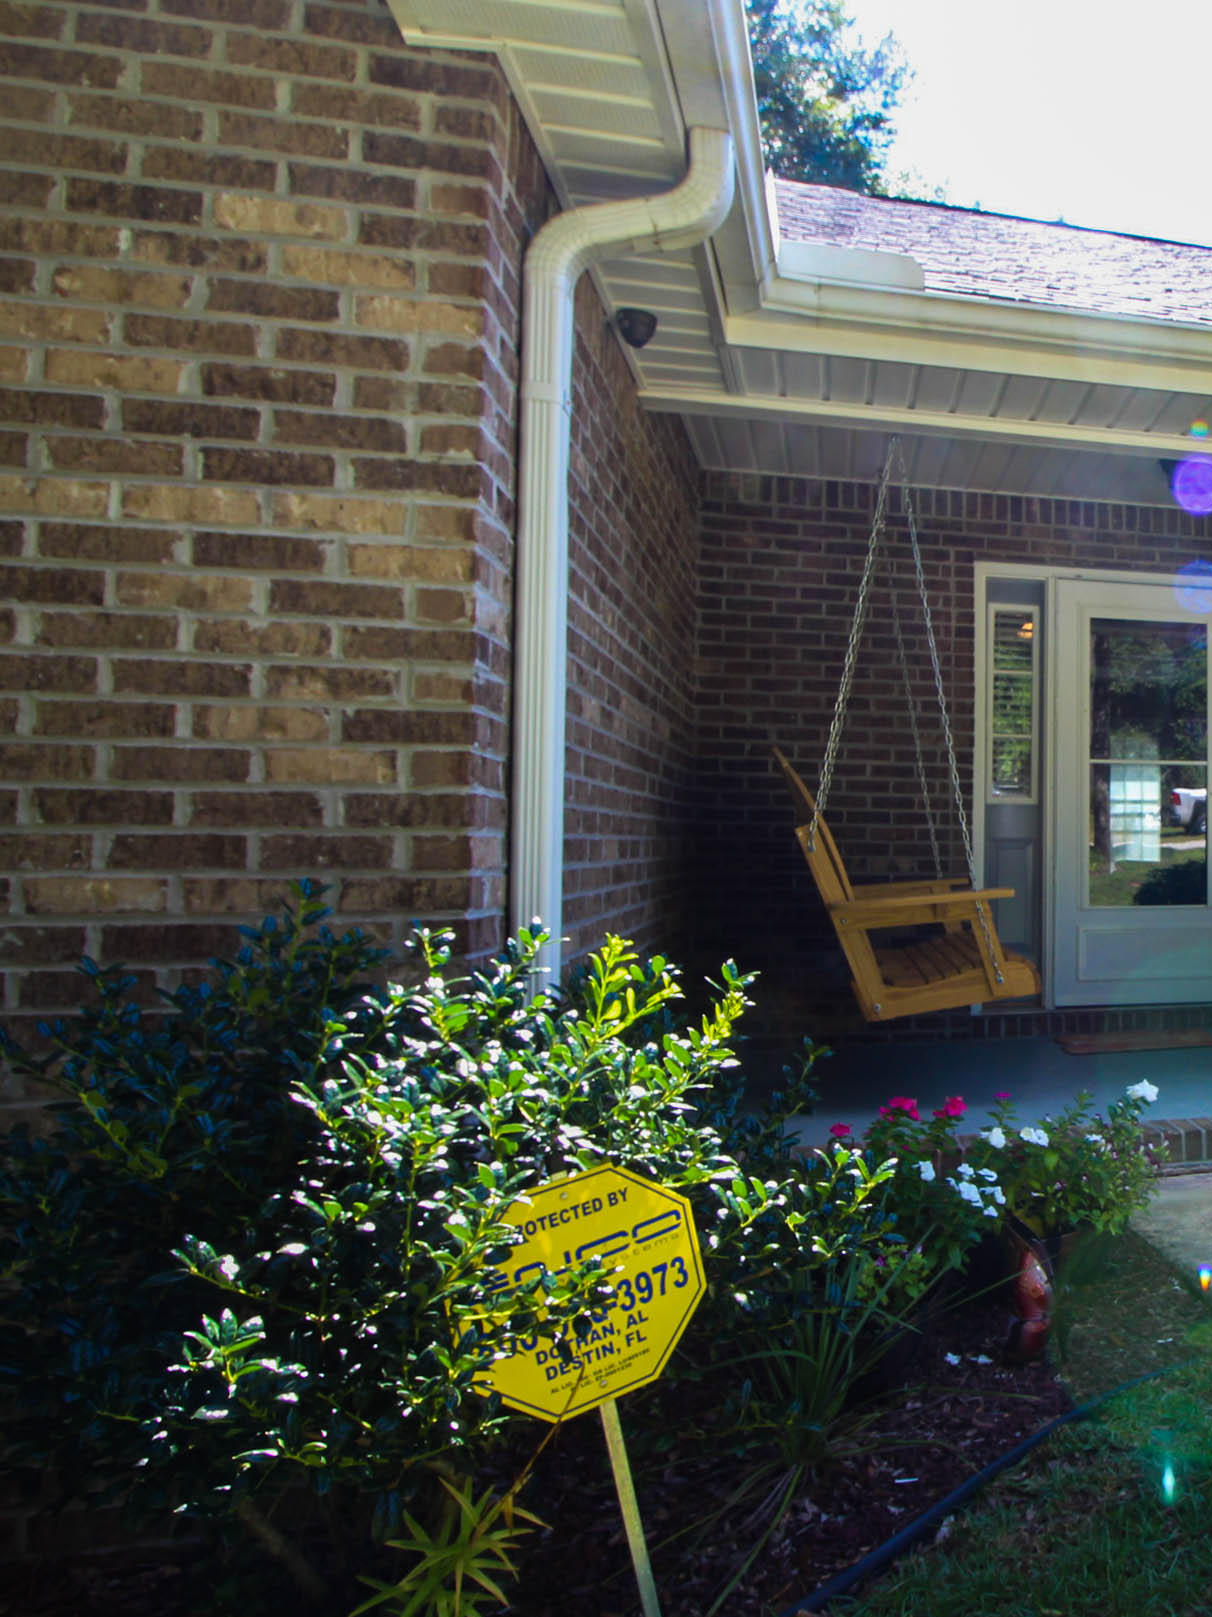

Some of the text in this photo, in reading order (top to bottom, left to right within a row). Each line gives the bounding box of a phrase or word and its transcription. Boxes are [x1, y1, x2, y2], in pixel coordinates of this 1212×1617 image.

[608, 1187, 628, 1207] BY
[627, 1310, 648, 1329] AL
[545, 1341, 621, 1381] DESTIN,
[625, 1329, 648, 1347] FL
